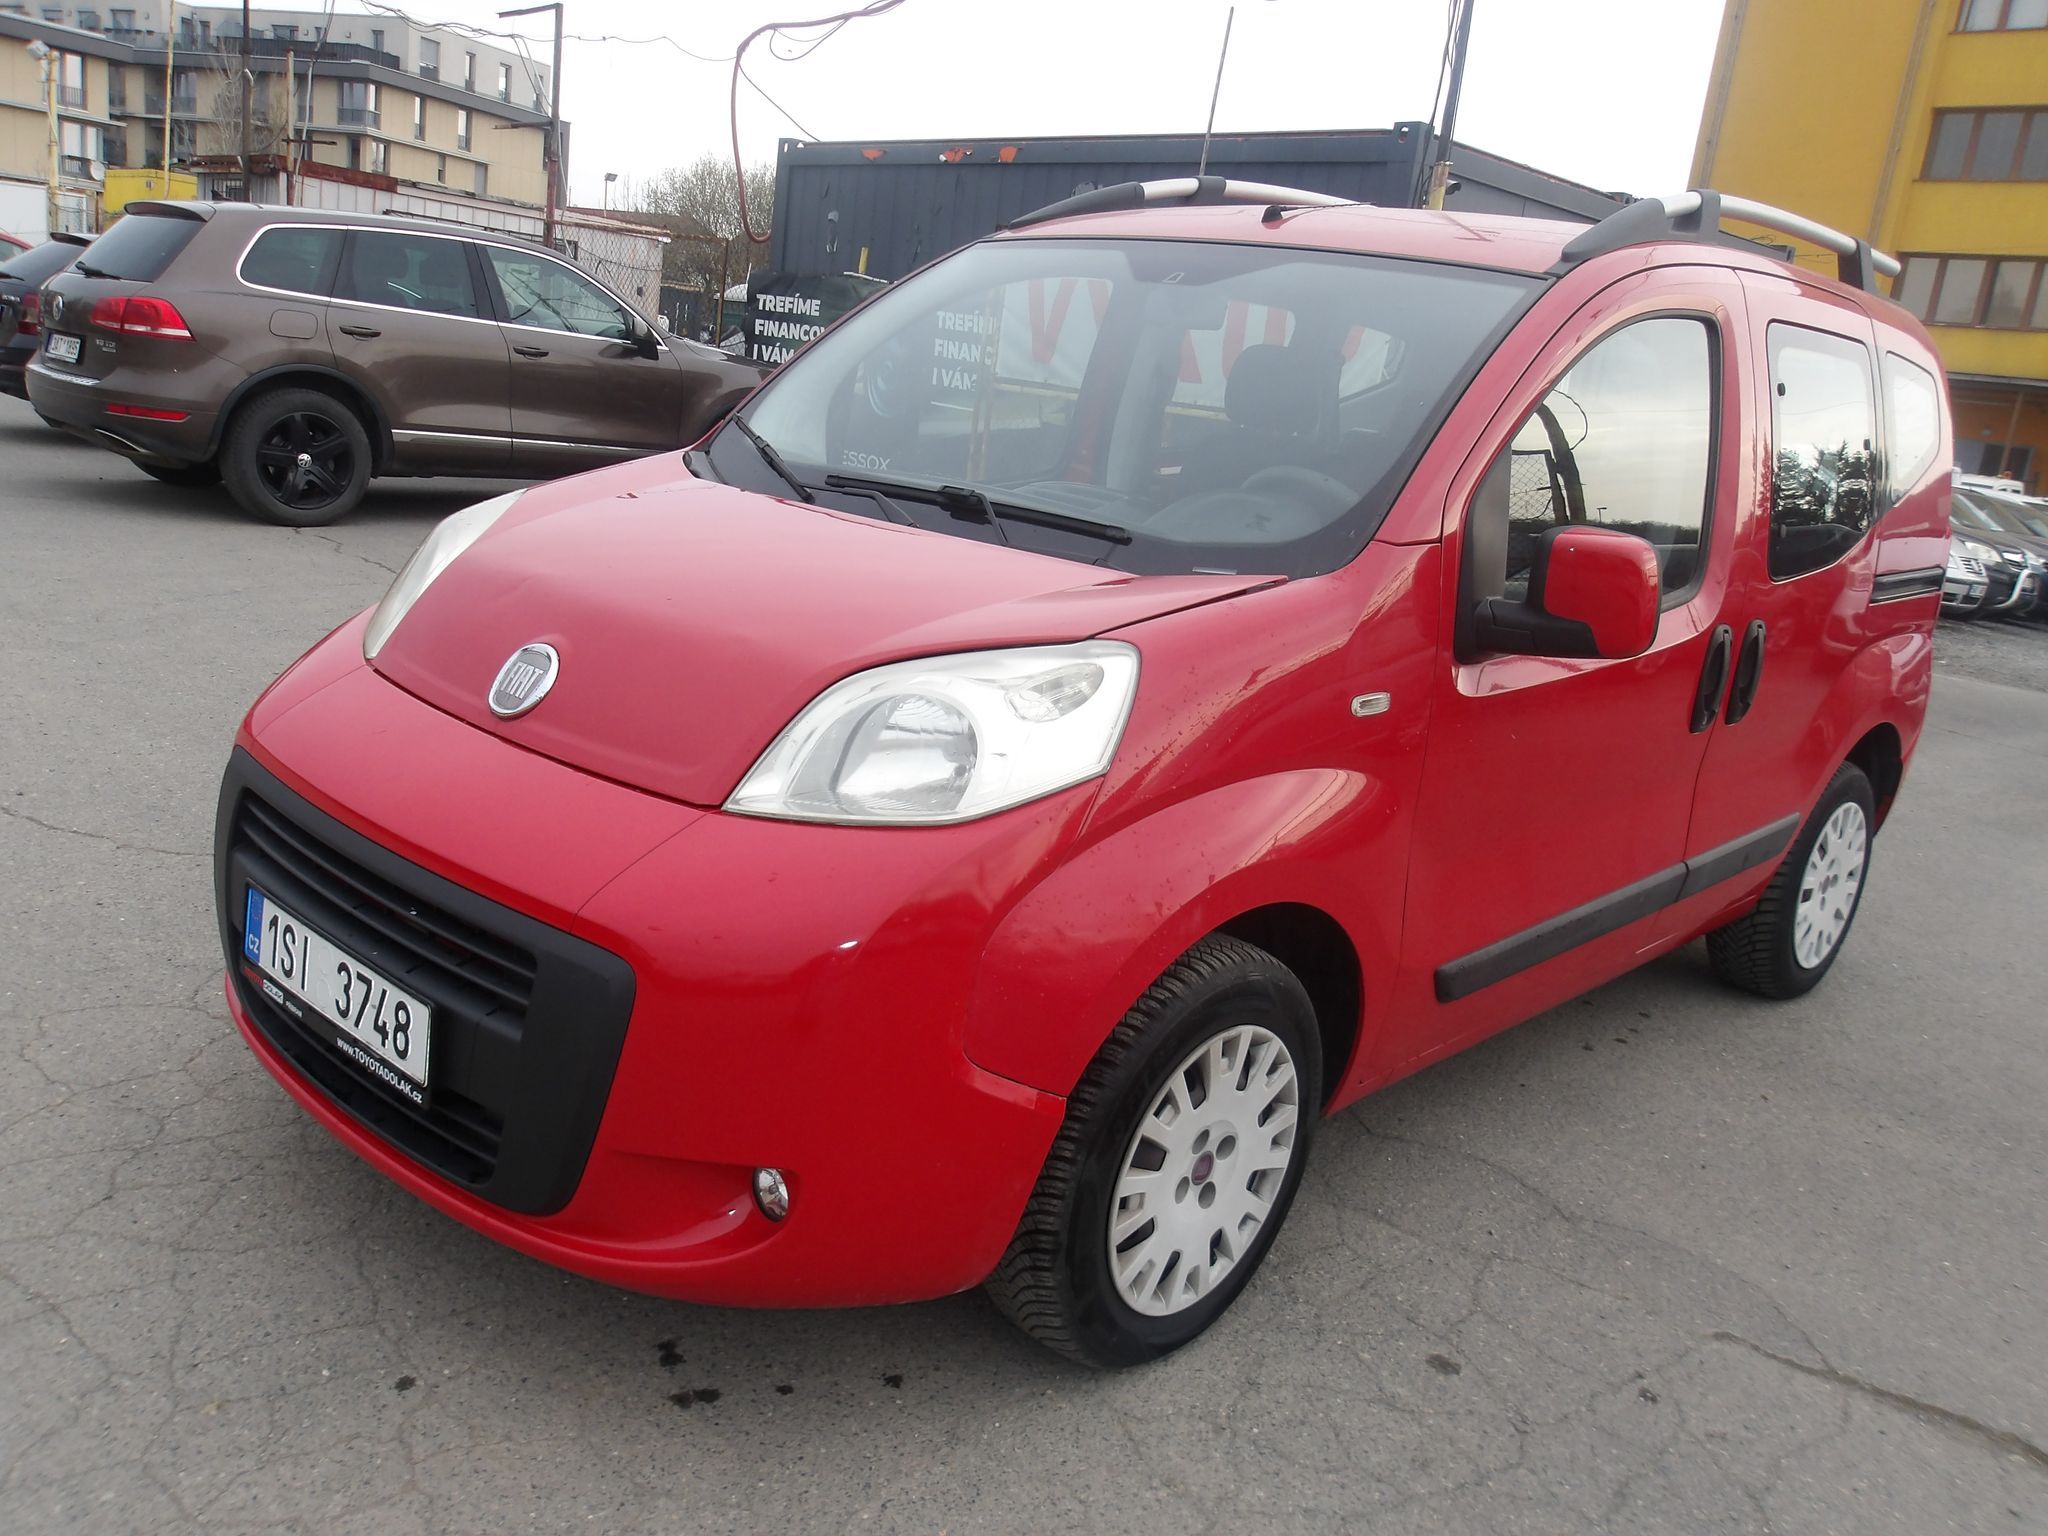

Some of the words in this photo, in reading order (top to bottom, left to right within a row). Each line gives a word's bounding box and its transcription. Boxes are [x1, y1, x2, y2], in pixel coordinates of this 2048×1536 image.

[756, 293, 821, 317] TREFÍME
[752, 344, 759, 360] I
[761, 342, 795, 364] VÁM
[500, 661, 545, 700] FIAT
[248, 933, 260, 954] CZ
[268, 914, 309, 992] 1SI
[335, 961, 412, 1061] 3748
[336, 1036, 423, 1104] www.TOYOTADOLAK.cz
